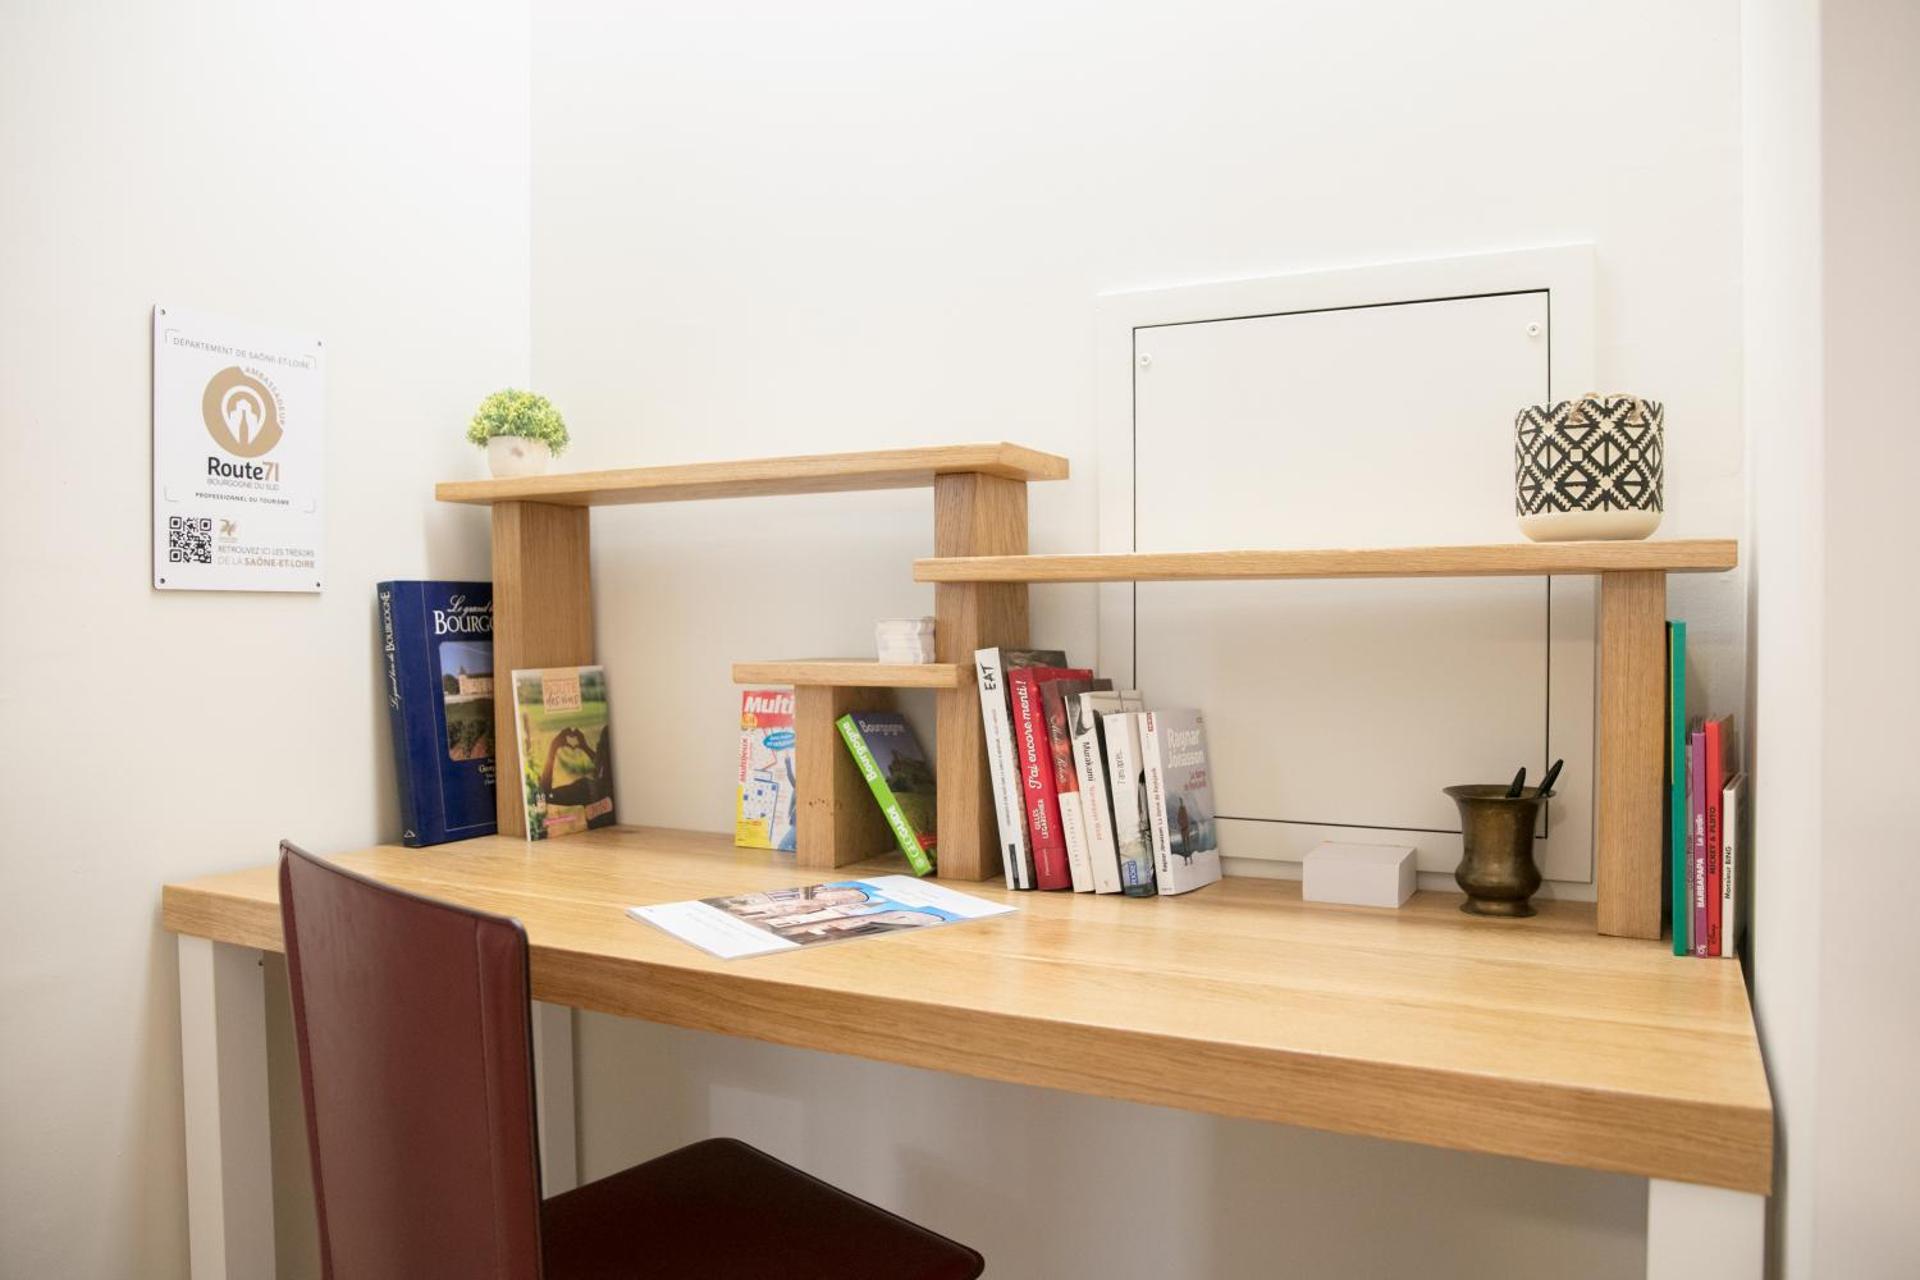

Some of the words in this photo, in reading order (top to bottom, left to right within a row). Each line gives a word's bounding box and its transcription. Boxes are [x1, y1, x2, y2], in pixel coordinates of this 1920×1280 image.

[195, 491, 247, 502] PROFESSIONNEL
[206, 478, 252, 490] BOURGOGNE
[254, 482, 265, 490] DU
[218, 545, 259, 555] RETROUVEZ
[447, 594, 466, 612] Le
[381, 591, 395, 651] BOURGOGNE
[433, 610, 494, 635] BOURG
[981, 663, 997, 691] EAT
[843, 721, 877, 782] Bourgogne
[1023, 721, 1037, 762] encore
[1168, 727, 1200, 751] Ragnar
[1083, 741, 1093, 782] Murakami
[1028, 765, 1043, 789] J'ai
[1032, 808, 1042, 831] GILLES
[1708, 807, 1716, 834] PLUTO
[1697, 858, 1705, 908] BARBAPAPA
